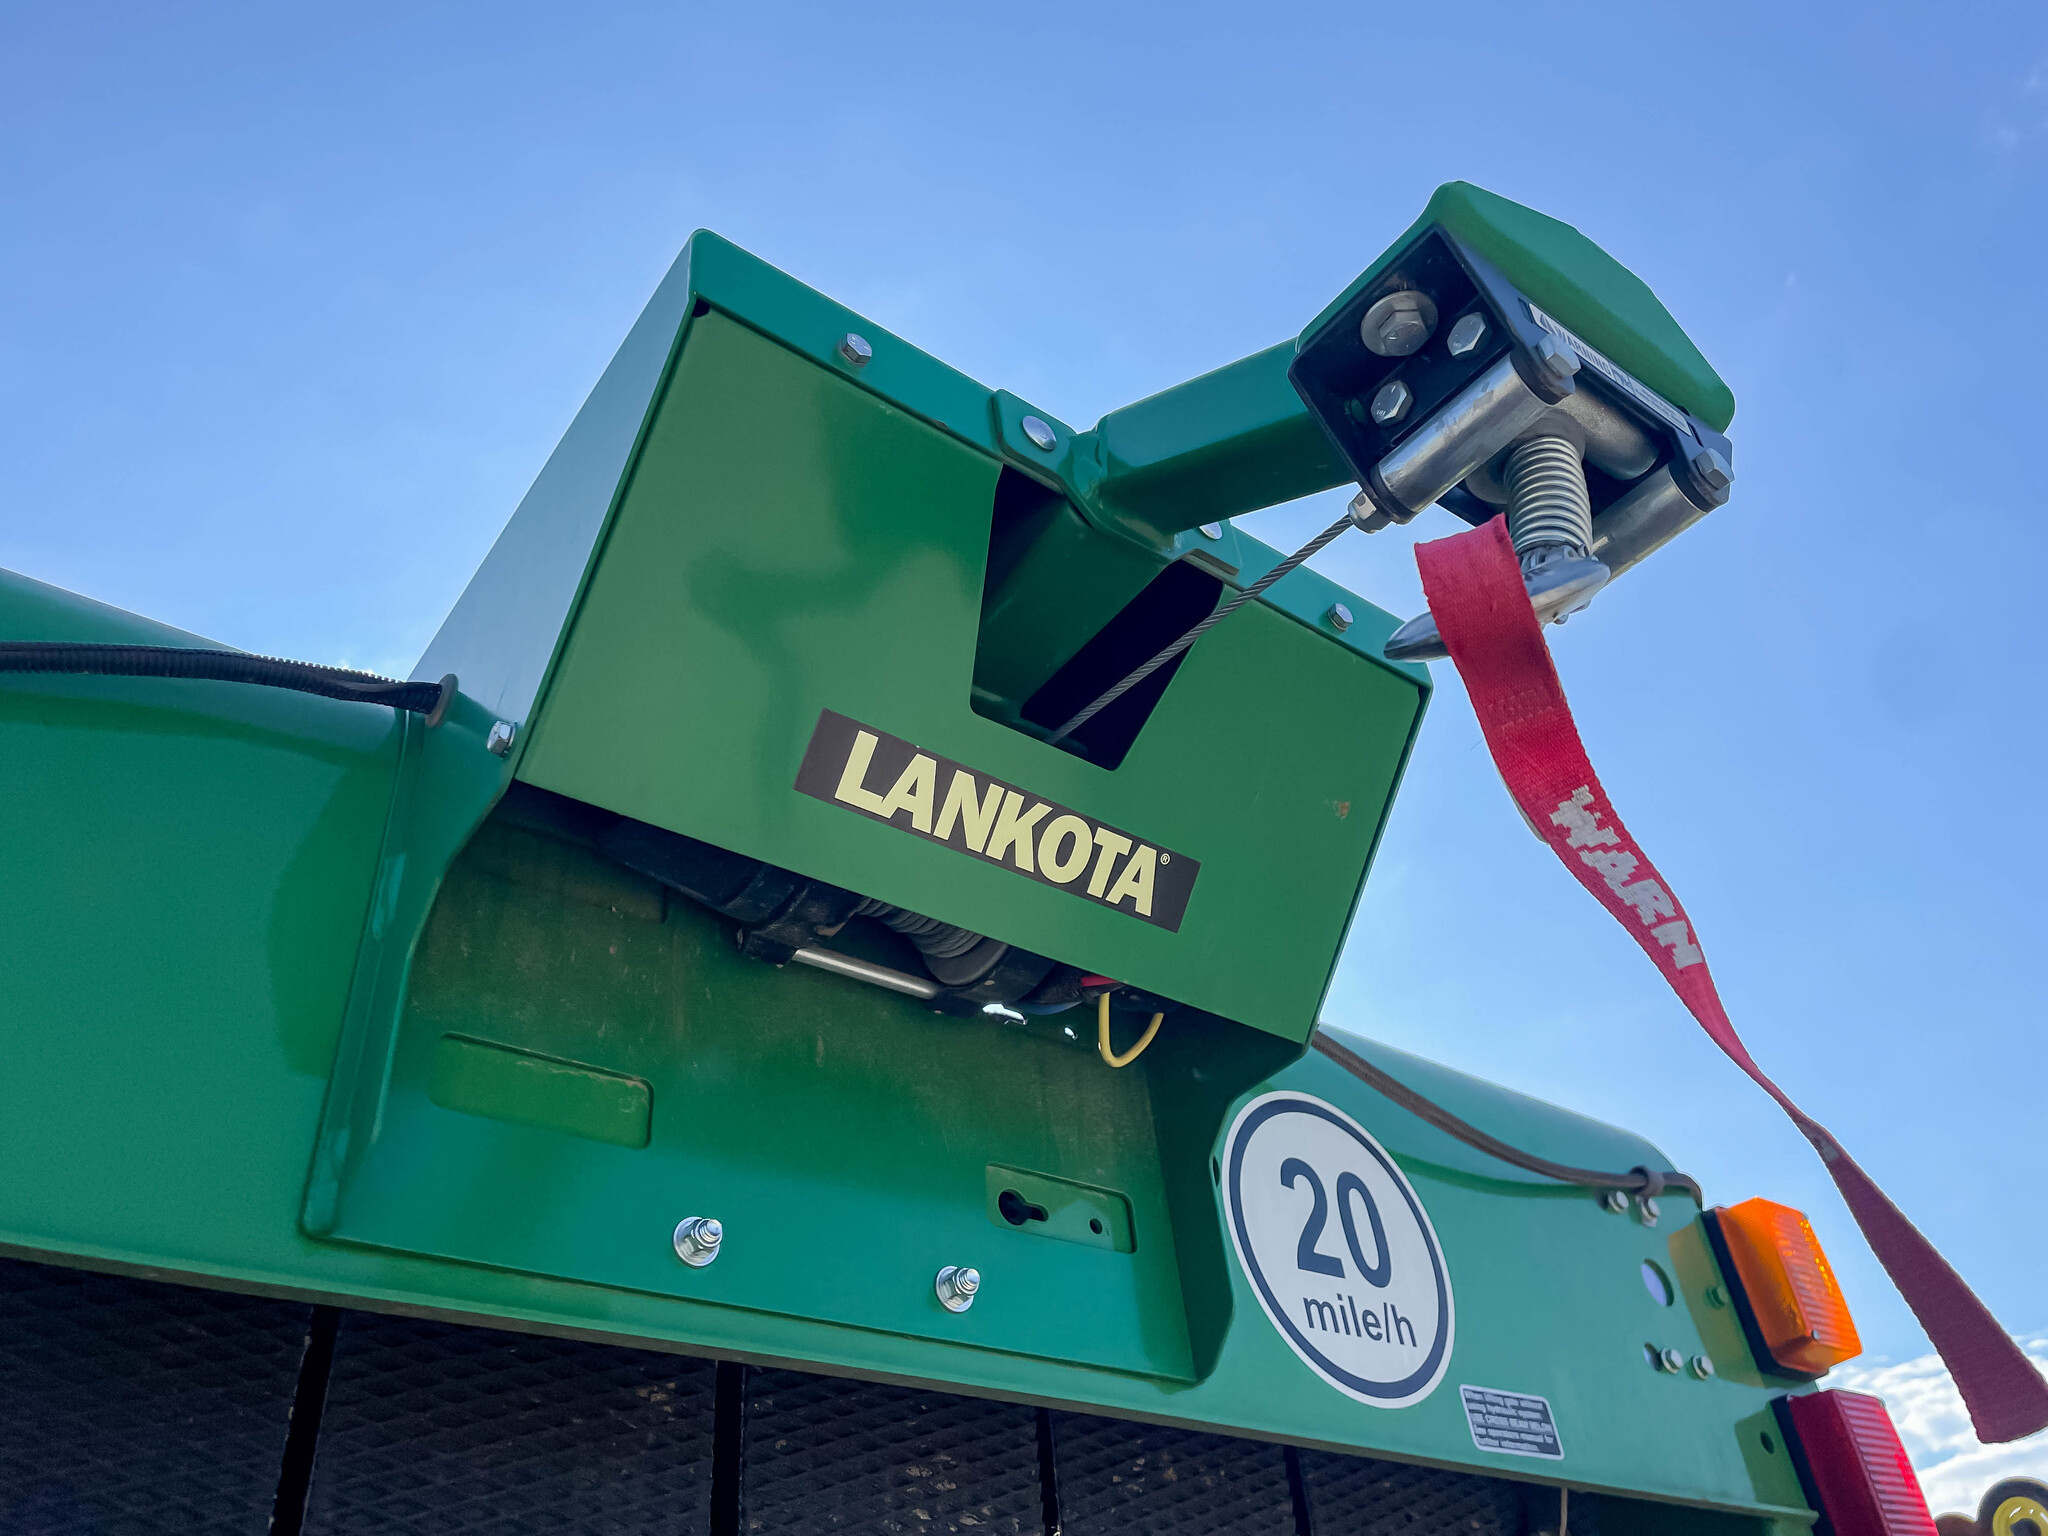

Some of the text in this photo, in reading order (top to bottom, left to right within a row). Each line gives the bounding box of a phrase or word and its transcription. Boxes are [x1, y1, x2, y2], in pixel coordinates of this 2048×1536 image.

[1549, 784, 1704, 970] WARN
[1280, 1157, 1392, 1289] 20
[1303, 1293, 1418, 1348] mile/h
